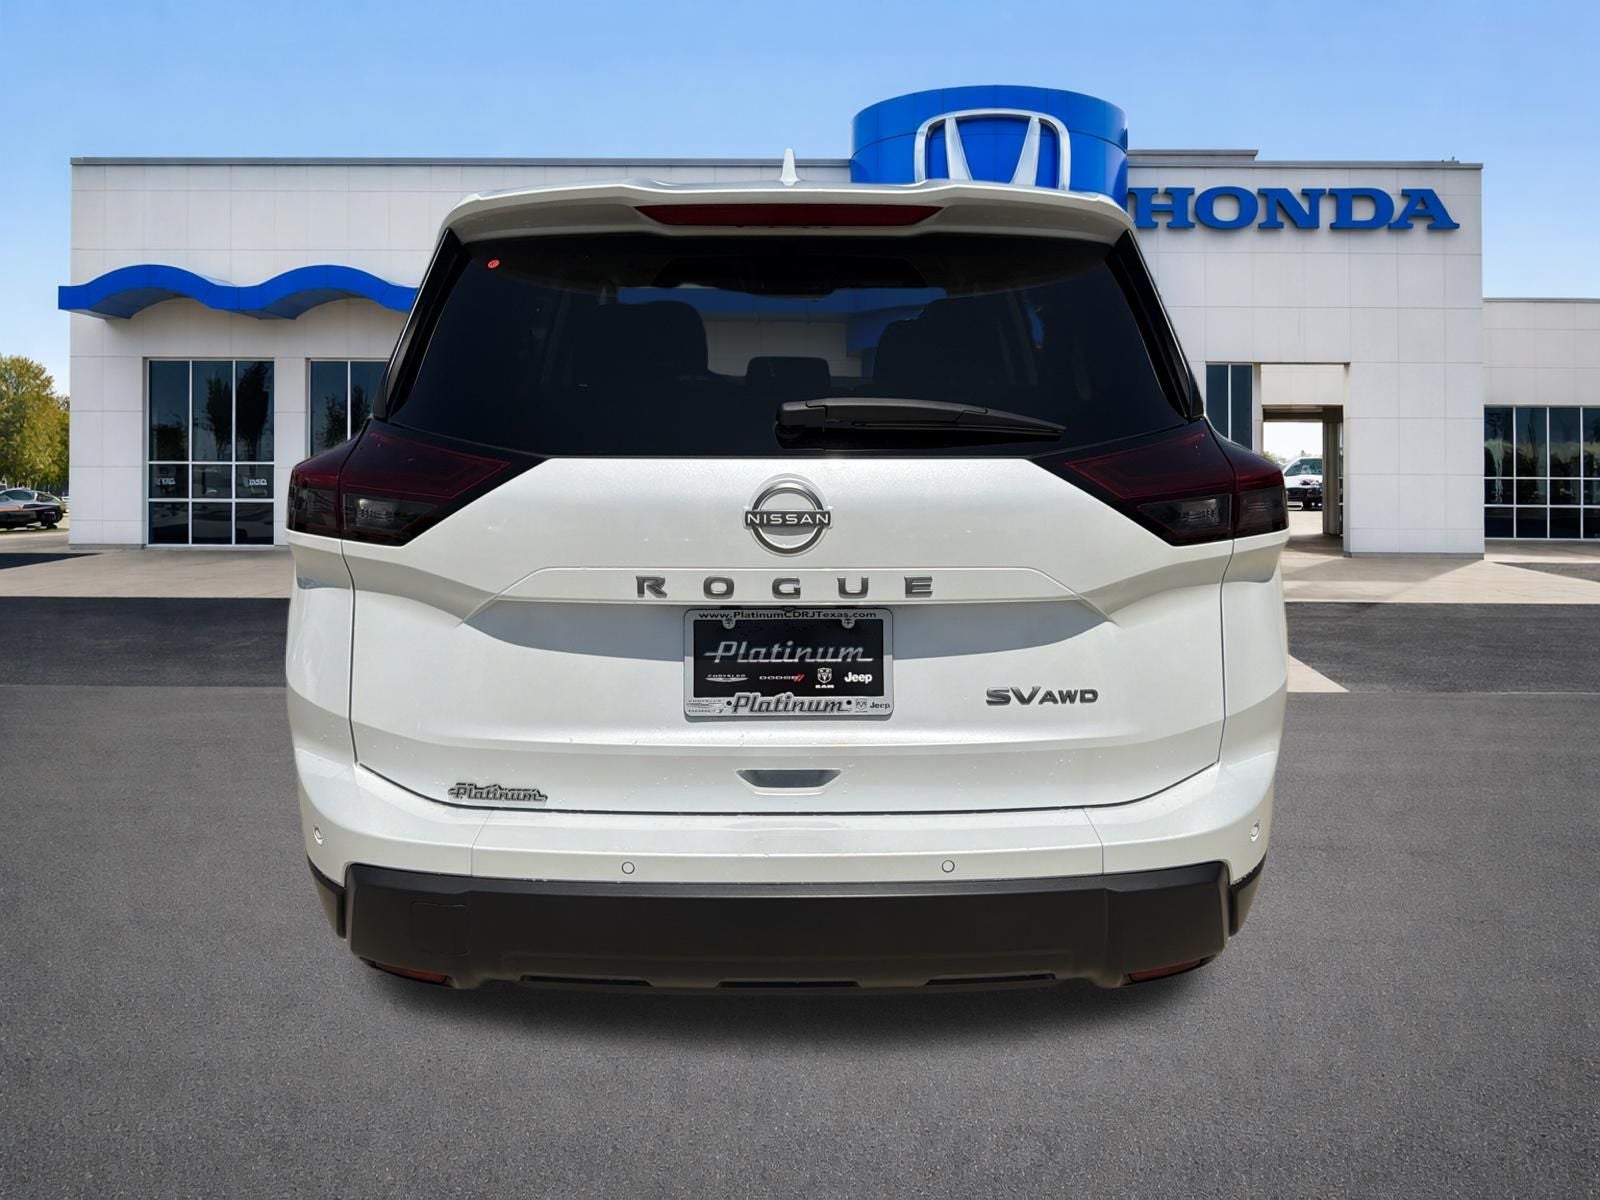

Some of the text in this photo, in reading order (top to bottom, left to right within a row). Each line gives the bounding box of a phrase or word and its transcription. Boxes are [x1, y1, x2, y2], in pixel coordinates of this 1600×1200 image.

[1128, 186, 1460, 229] HONDA
[747, 512, 829, 525] NISSAN
[636, 575, 933, 600] ROGUE
[699, 610, 877, 619] www.PlatinumCDRJTexas.com
[704, 640, 873, 663] Platinum
[844, 672, 873, 684] Jeep
[732, 694, 852, 713] Platinum
[870, 701, 890, 709] Jeep
[448, 782, 548, 801] Platinum
